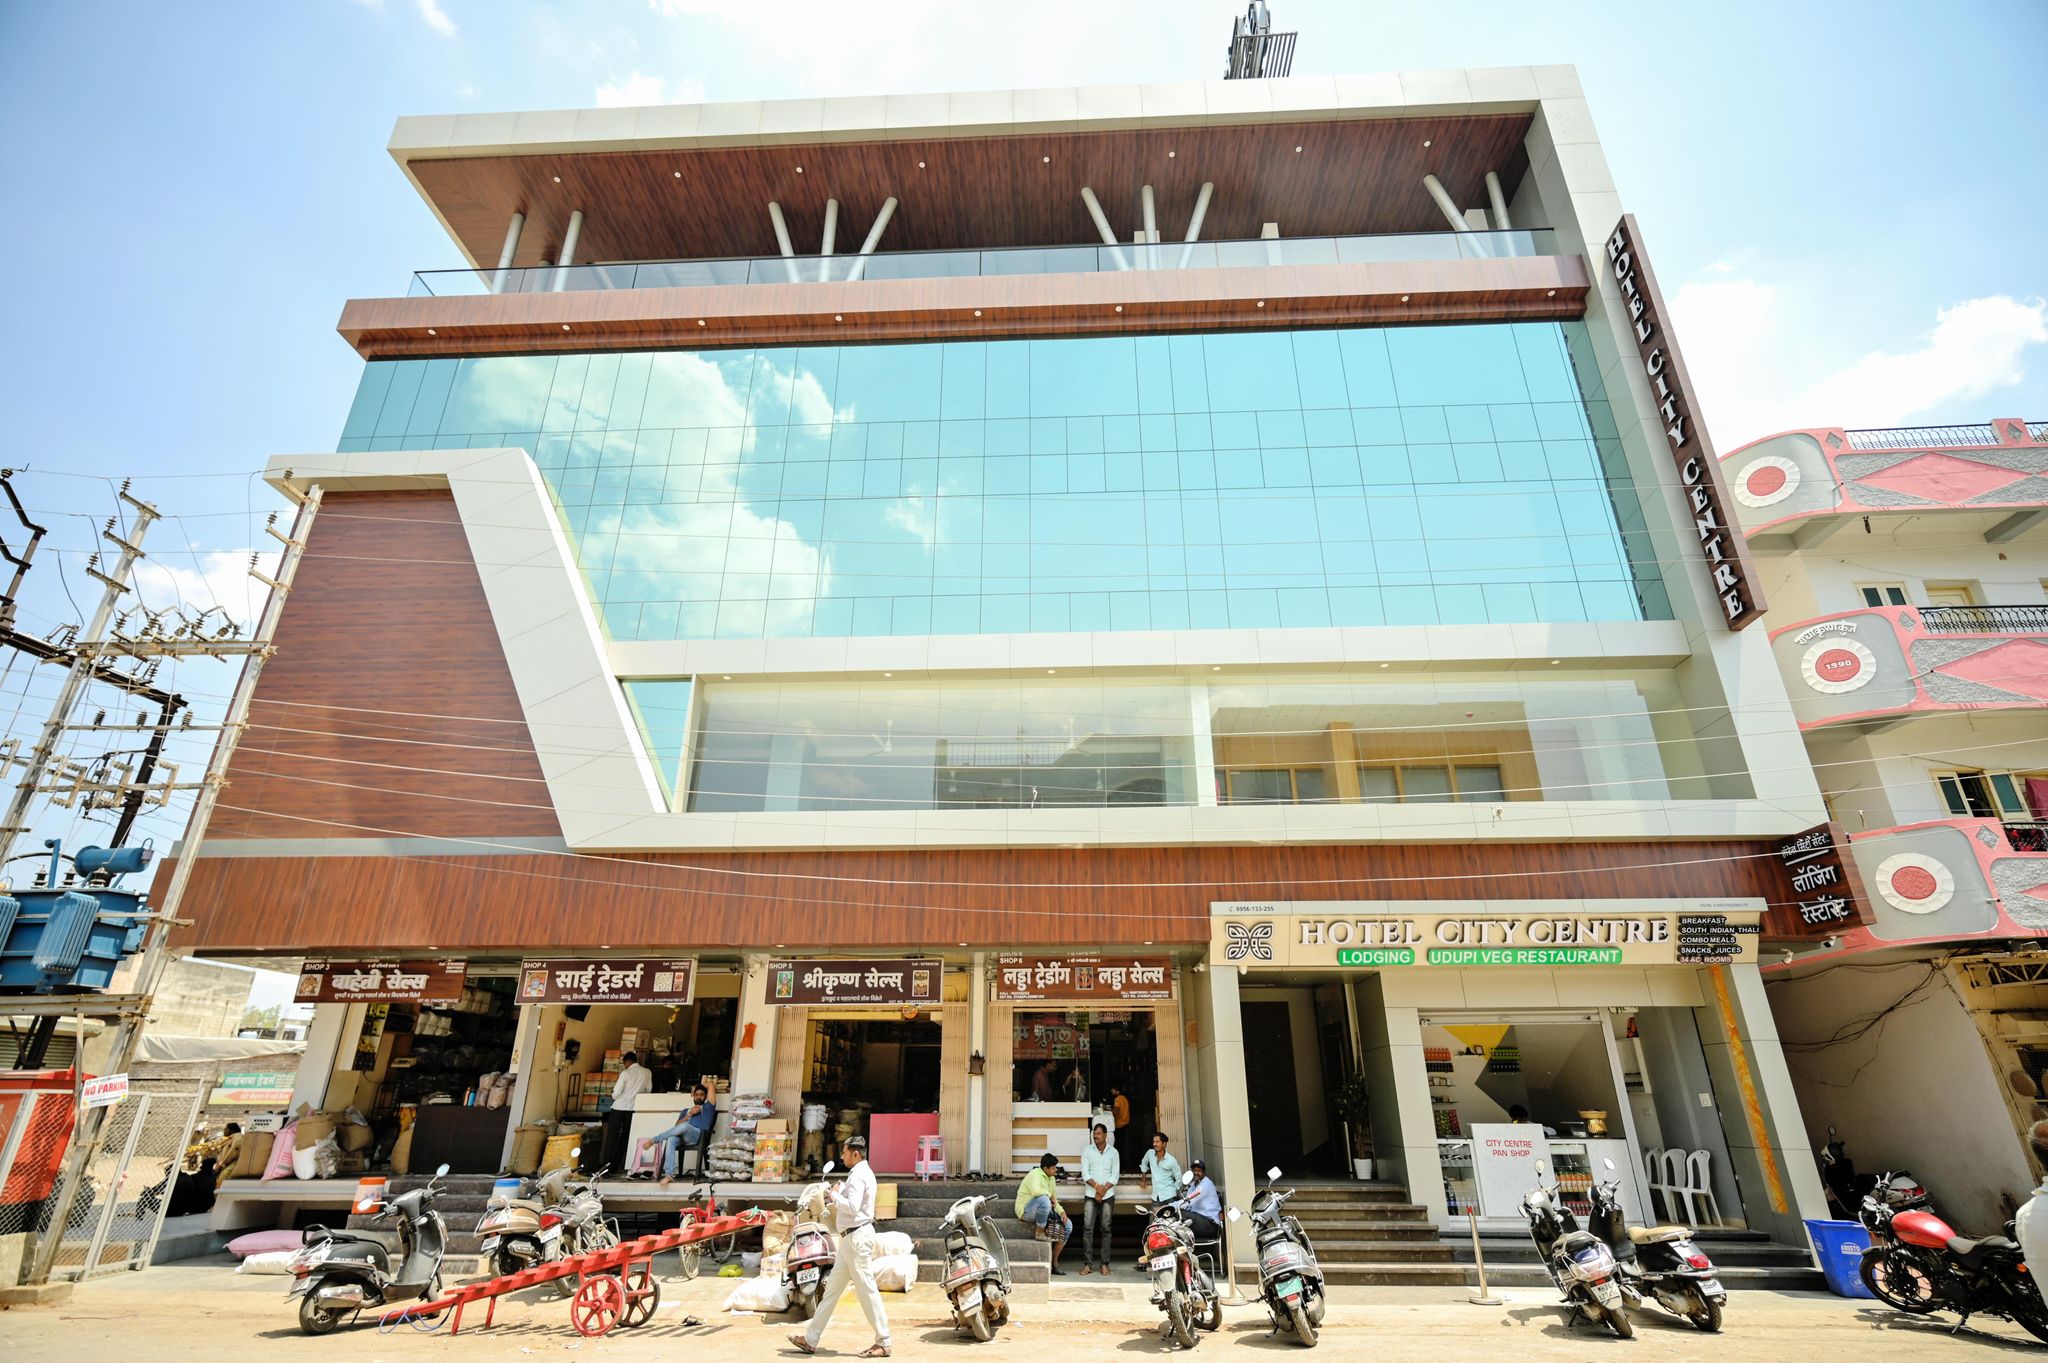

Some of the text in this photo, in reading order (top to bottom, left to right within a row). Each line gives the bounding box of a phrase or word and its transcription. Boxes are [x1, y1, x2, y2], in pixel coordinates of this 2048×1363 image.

[1607, 227, 1744, 620] HOTEL CITY CENTRE
[1791, 864, 1837, 892] लॉजिंग
[1299, 918, 1670, 946] HOTEL CITY CENTRE
[1342, 951, 1411, 964] LODGING
[1431, 950, 1621, 964] UDUPI VEG RESTAURANT
[1714, 946, 1742, 954] JUICES
[305, 963, 324, 971] SHOP
[555, 963, 645, 993] साई ट्रेडर्स
[1129, 961, 1164, 985] सेल्स
[386, 968, 430, 990] सेल्स
[802, 967, 862, 994] श्रीकृष्ण
[84, 1080, 127, 1096] NO PARKING
[1485, 1139, 1533, 1148] CITY CENTRE
